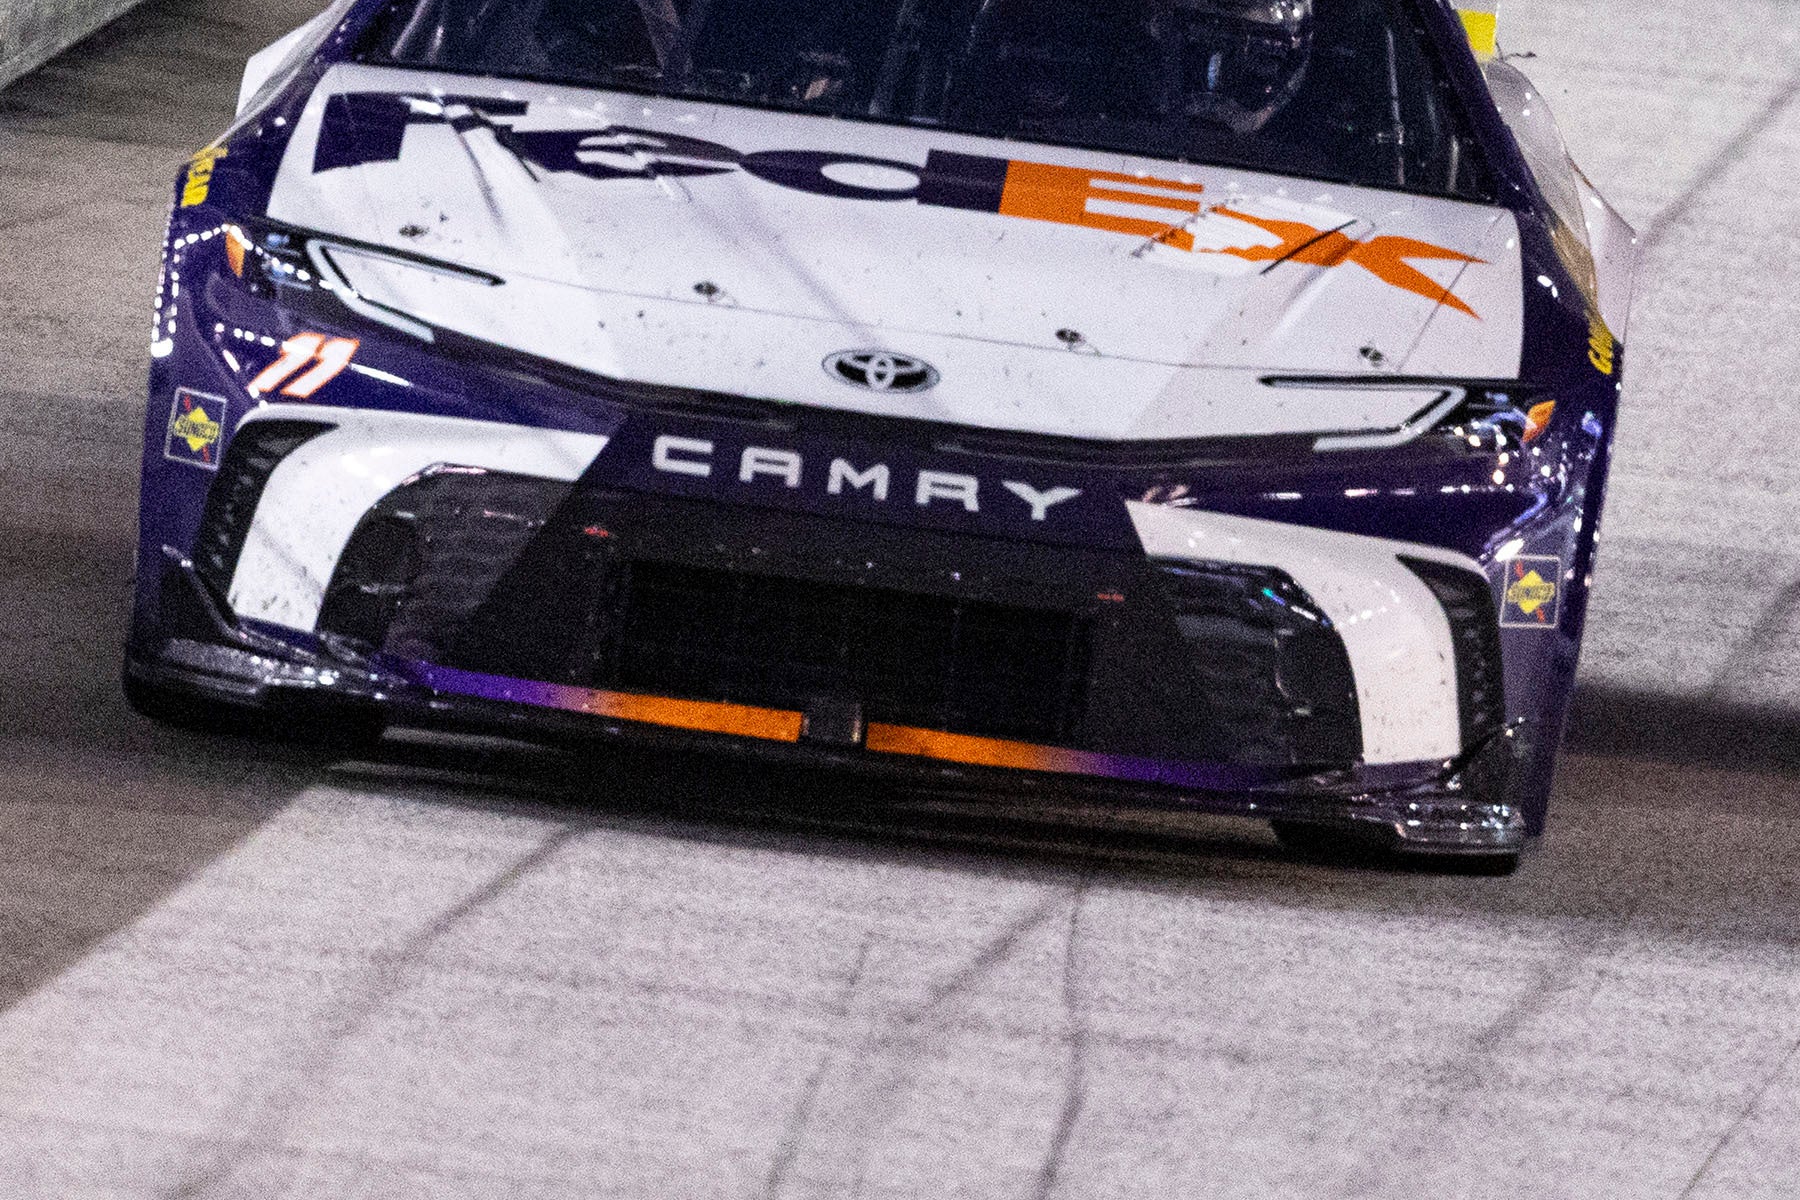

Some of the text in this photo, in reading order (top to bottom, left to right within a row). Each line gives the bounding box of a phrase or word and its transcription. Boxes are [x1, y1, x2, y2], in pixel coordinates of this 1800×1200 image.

[313, 92, 1490, 321] FedEx
[247, 333, 360, 398] 11
[652, 435, 1082, 521] CAMRY
